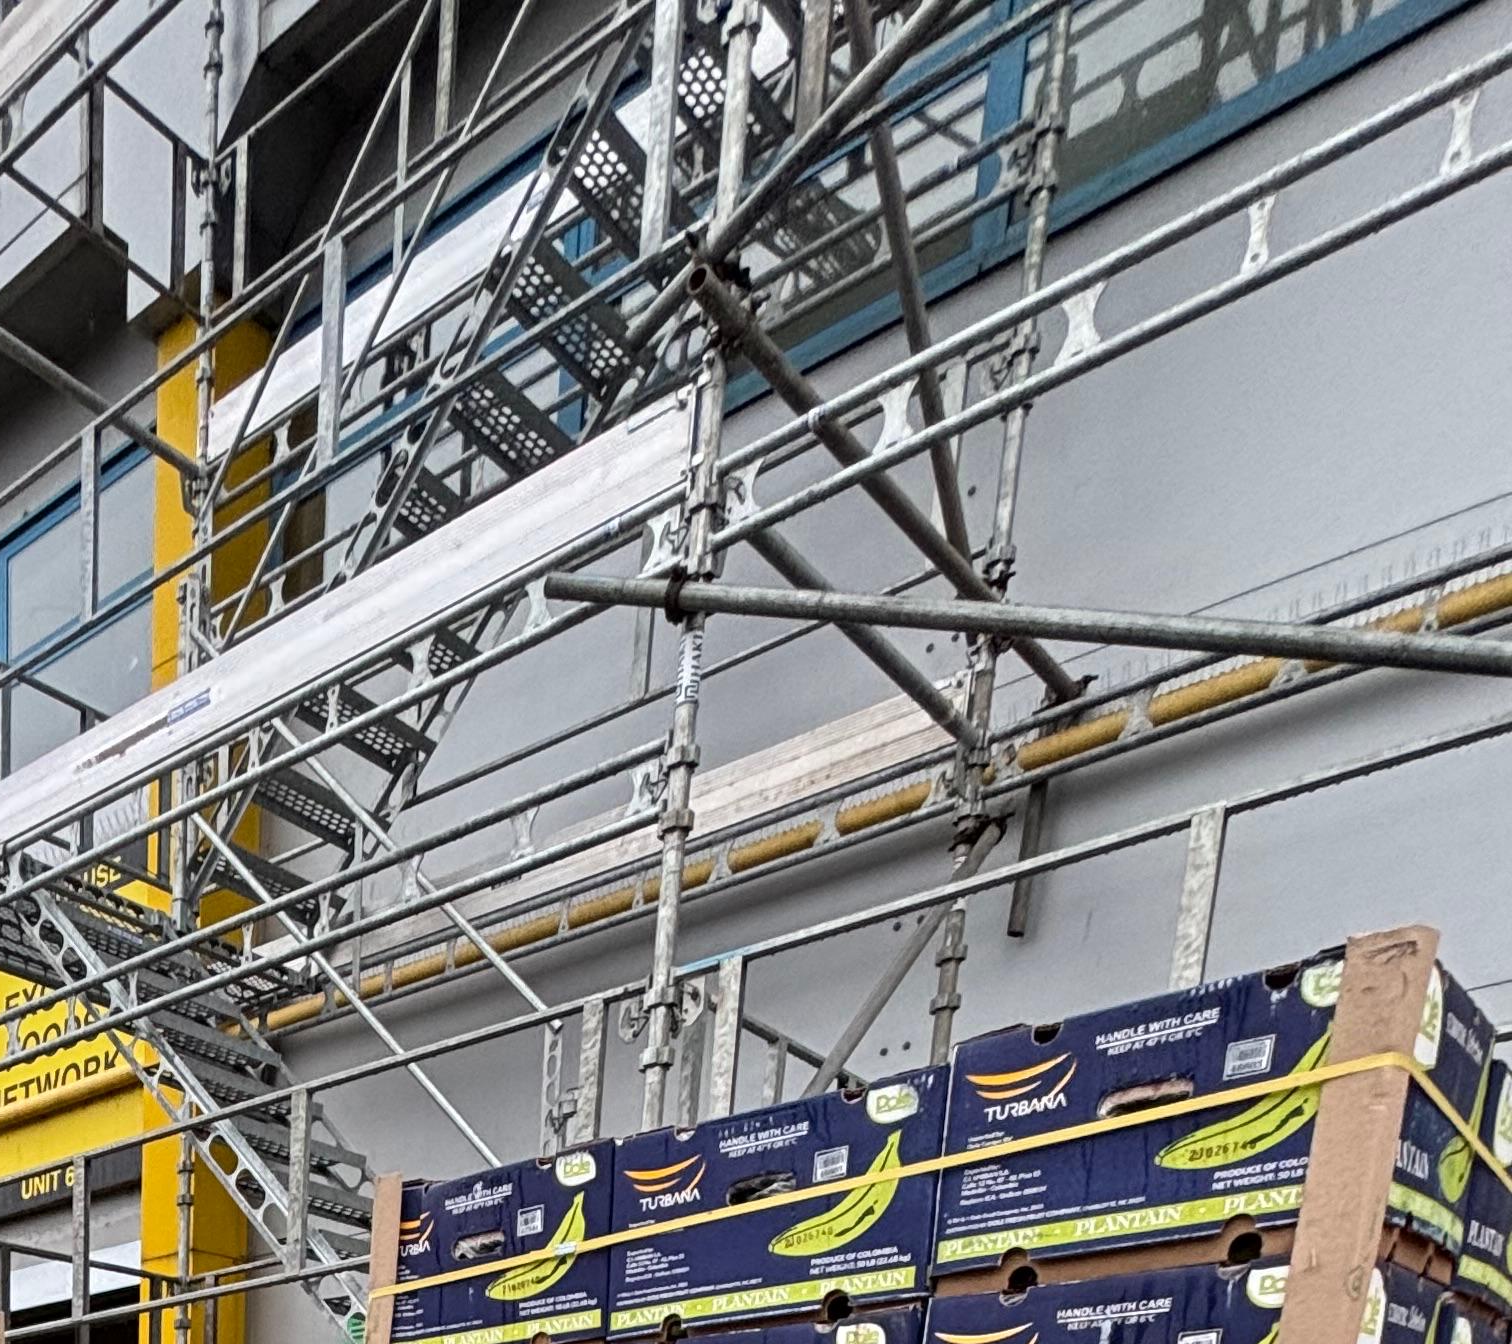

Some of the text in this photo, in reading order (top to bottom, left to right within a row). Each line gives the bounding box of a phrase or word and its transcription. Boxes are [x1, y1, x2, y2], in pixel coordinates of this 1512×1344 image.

[1096, 1007, 1221, 1047] HANDLE WITH CARE
[984, 1092, 1067, 1122] TURBANA
[21, 1167, 76, 1200] UNIT 6
[1213, 1162, 1262, 1181] PRODUCE
[1212, 1180, 1231, 1191] NET
[639, 1187, 700, 1212] TURBANA
[944, 1205, 1184, 1257] PLANTAIN PLANTAIN
[712, 1288, 790, 1312] PLANTAIN
